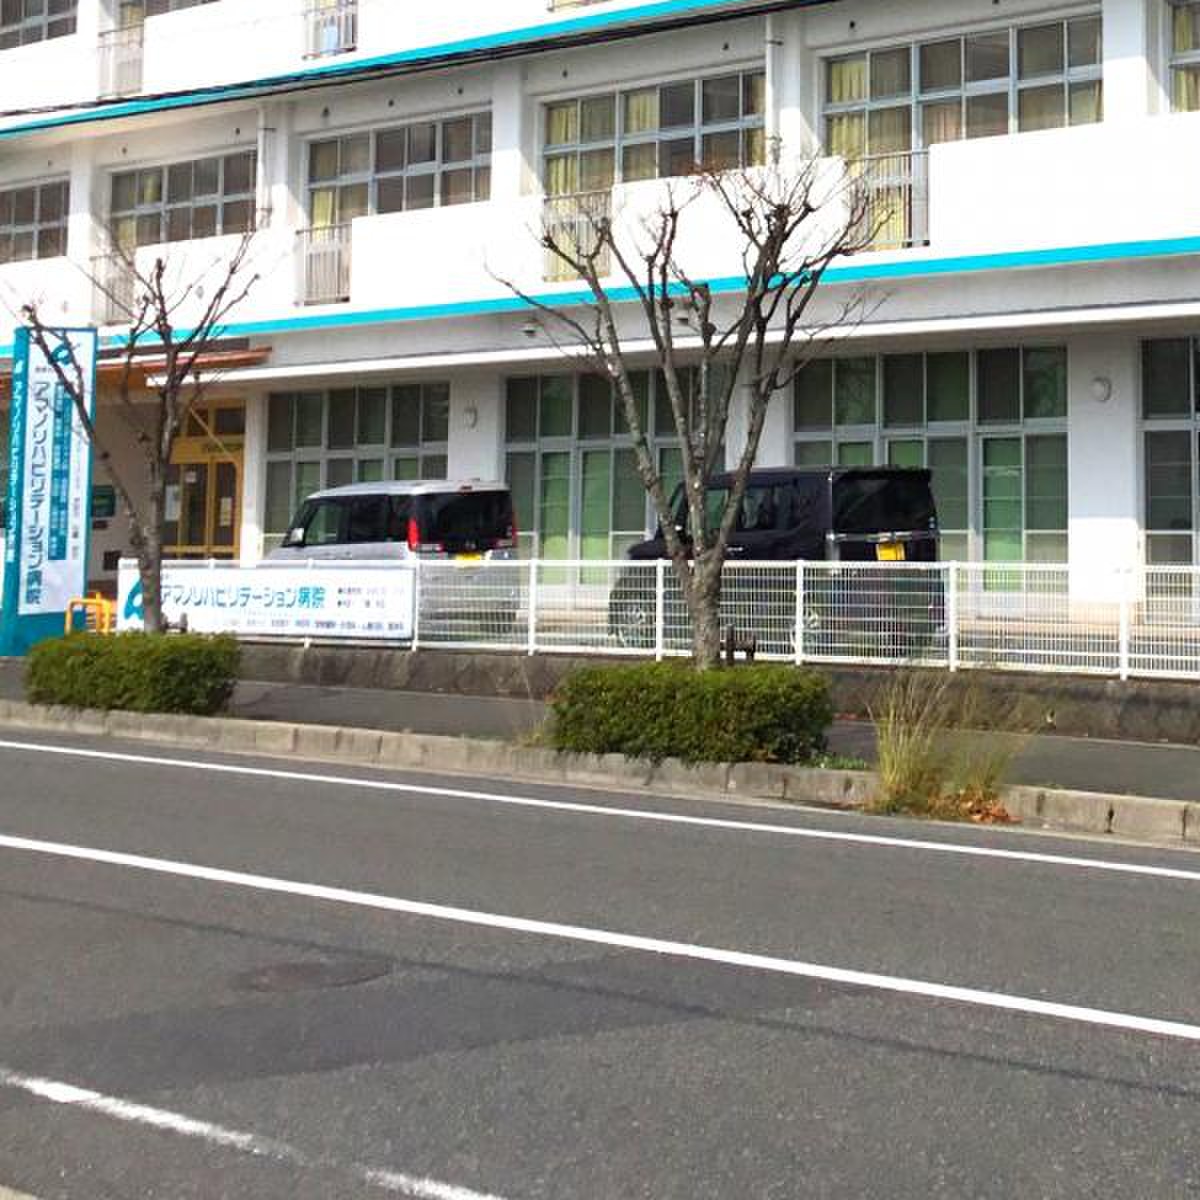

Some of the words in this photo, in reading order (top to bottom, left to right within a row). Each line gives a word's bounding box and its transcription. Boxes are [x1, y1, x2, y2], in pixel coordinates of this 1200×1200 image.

[26, 382, 49, 604] アマノリハビリテーション病院
[160, 584, 326, 608] アマノリハビリテーション病院
